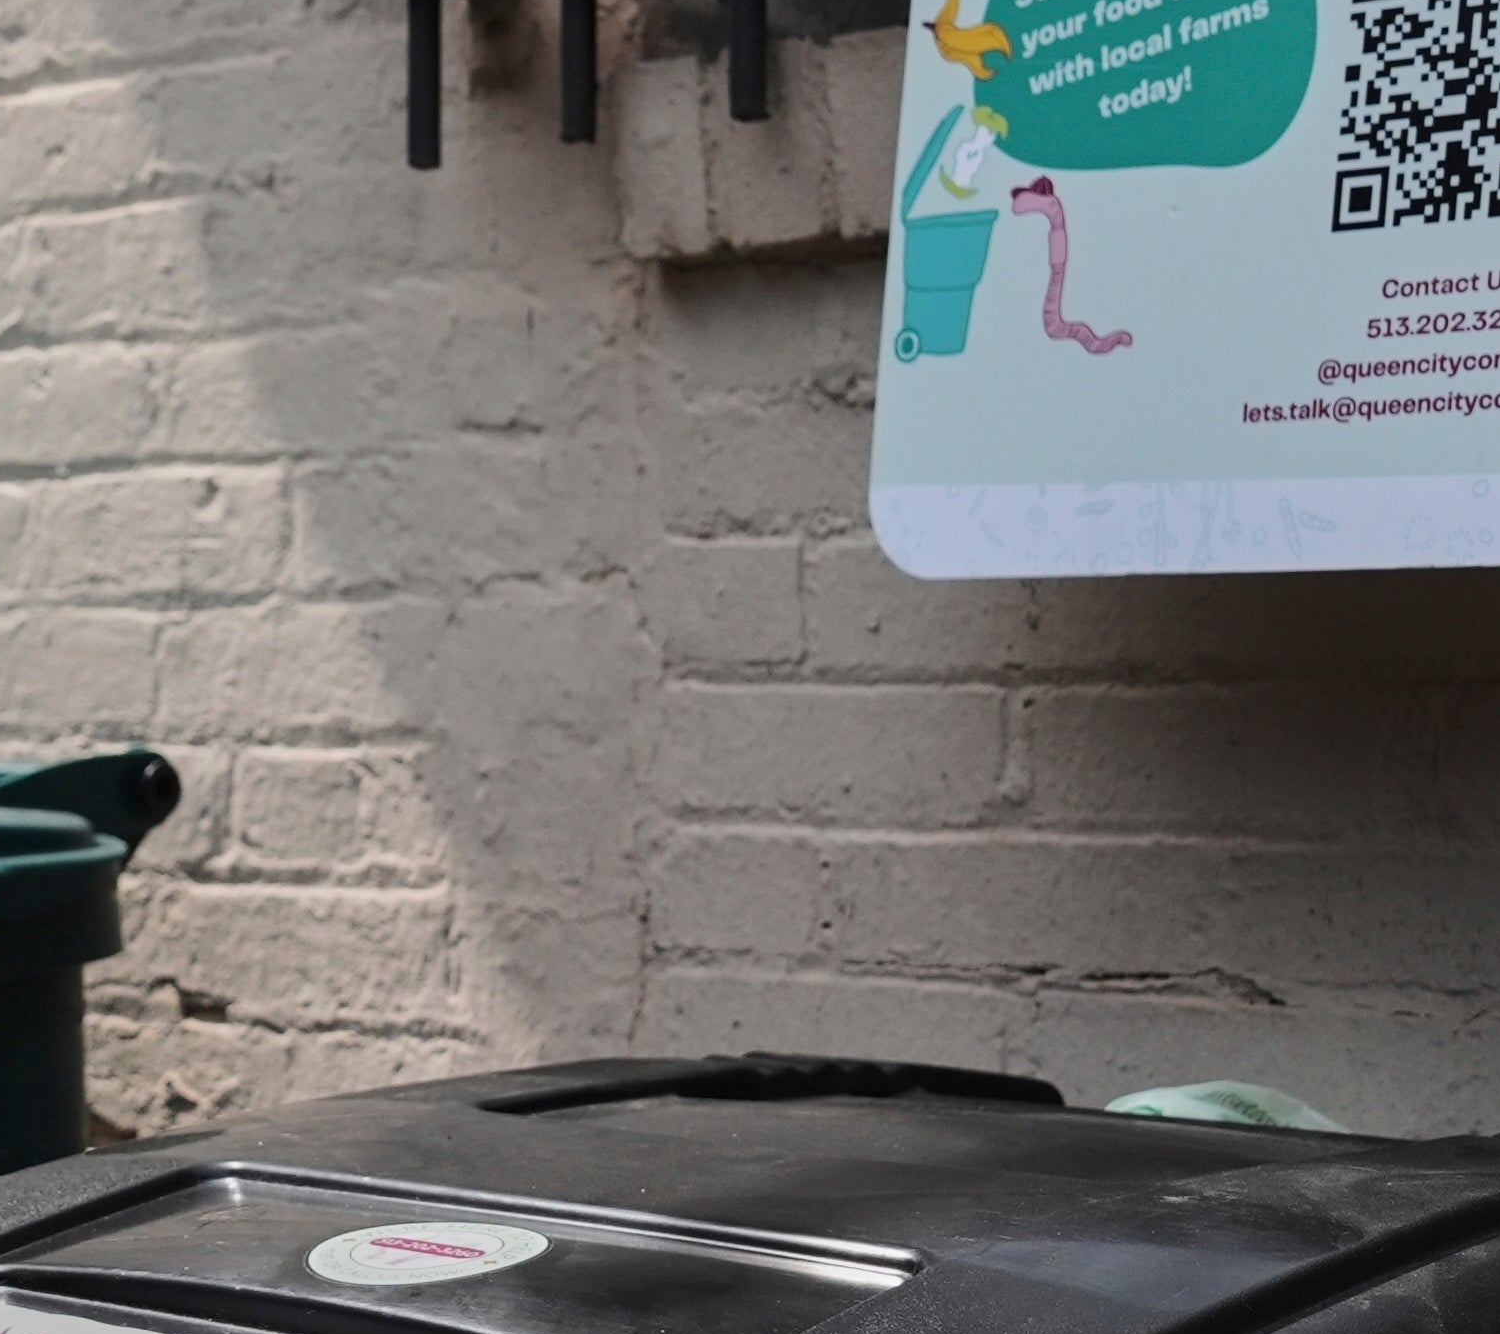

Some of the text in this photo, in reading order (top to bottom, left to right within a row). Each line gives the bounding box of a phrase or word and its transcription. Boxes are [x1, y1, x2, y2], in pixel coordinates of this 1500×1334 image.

[1021, 12, 1087, 59] your
[1029, 53, 1095, 95] with
[1101, 23, 1173, 71] local
[1098, 66, 1192, 118] today!
[1381, 274, 1480, 299] Contact
